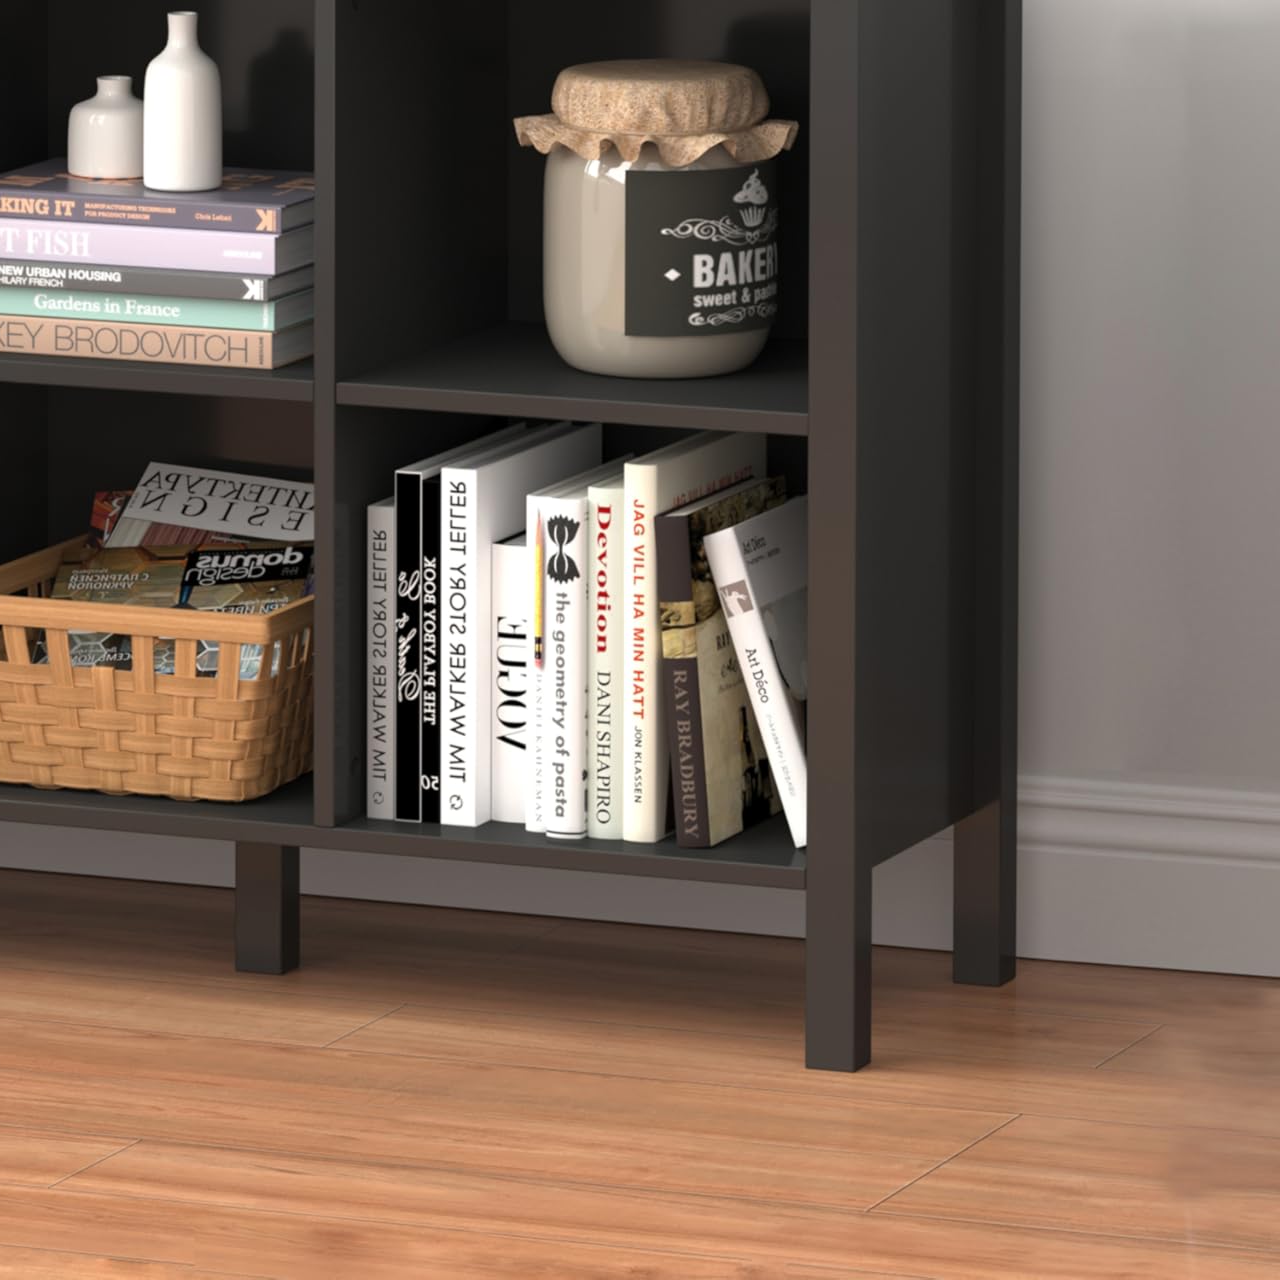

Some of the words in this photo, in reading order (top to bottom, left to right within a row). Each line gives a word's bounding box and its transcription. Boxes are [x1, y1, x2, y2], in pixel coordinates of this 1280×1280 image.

[54, 199, 76, 217] IT
[26, 228, 90, 258] FISH
[26, 267, 66, 280] URBAN
[68, 269, 122, 283] HOUSING
[29, 278, 64, 288] FRENCH
[34, 294, 101, 313] Gardens
[104, 298, 121, 314] in
[124, 299, 181, 318] France
[693, 289, 737, 308] sweet
[741, 287, 751, 304] &
[54, 324, 248, 363] BRODOVITCH
[633, 499, 645, 537] JAG
[597, 504, 612, 653] Devotion
[633, 544, 645, 585] VILL
[556, 592, 570, 624] the
[633, 593, 645, 619] HA
[633, 627, 645, 662] MIN
[552, 629, 567, 729] geometry
[632, 670, 644, 719] HATT
[673, 670, 691, 715] RAY
[745, 648, 758, 669] Art
[752, 669, 769, 704] Déco
[597, 671, 612, 725] DANI
[555, 736, 570, 757] of
[634, 725, 643, 748] JON
[552, 762, 567, 818] pasta
[596, 730, 612, 824] SHAPIRO
[634, 751, 643, 803] KLASSEN
[676, 719, 700, 839] BRADBURY
